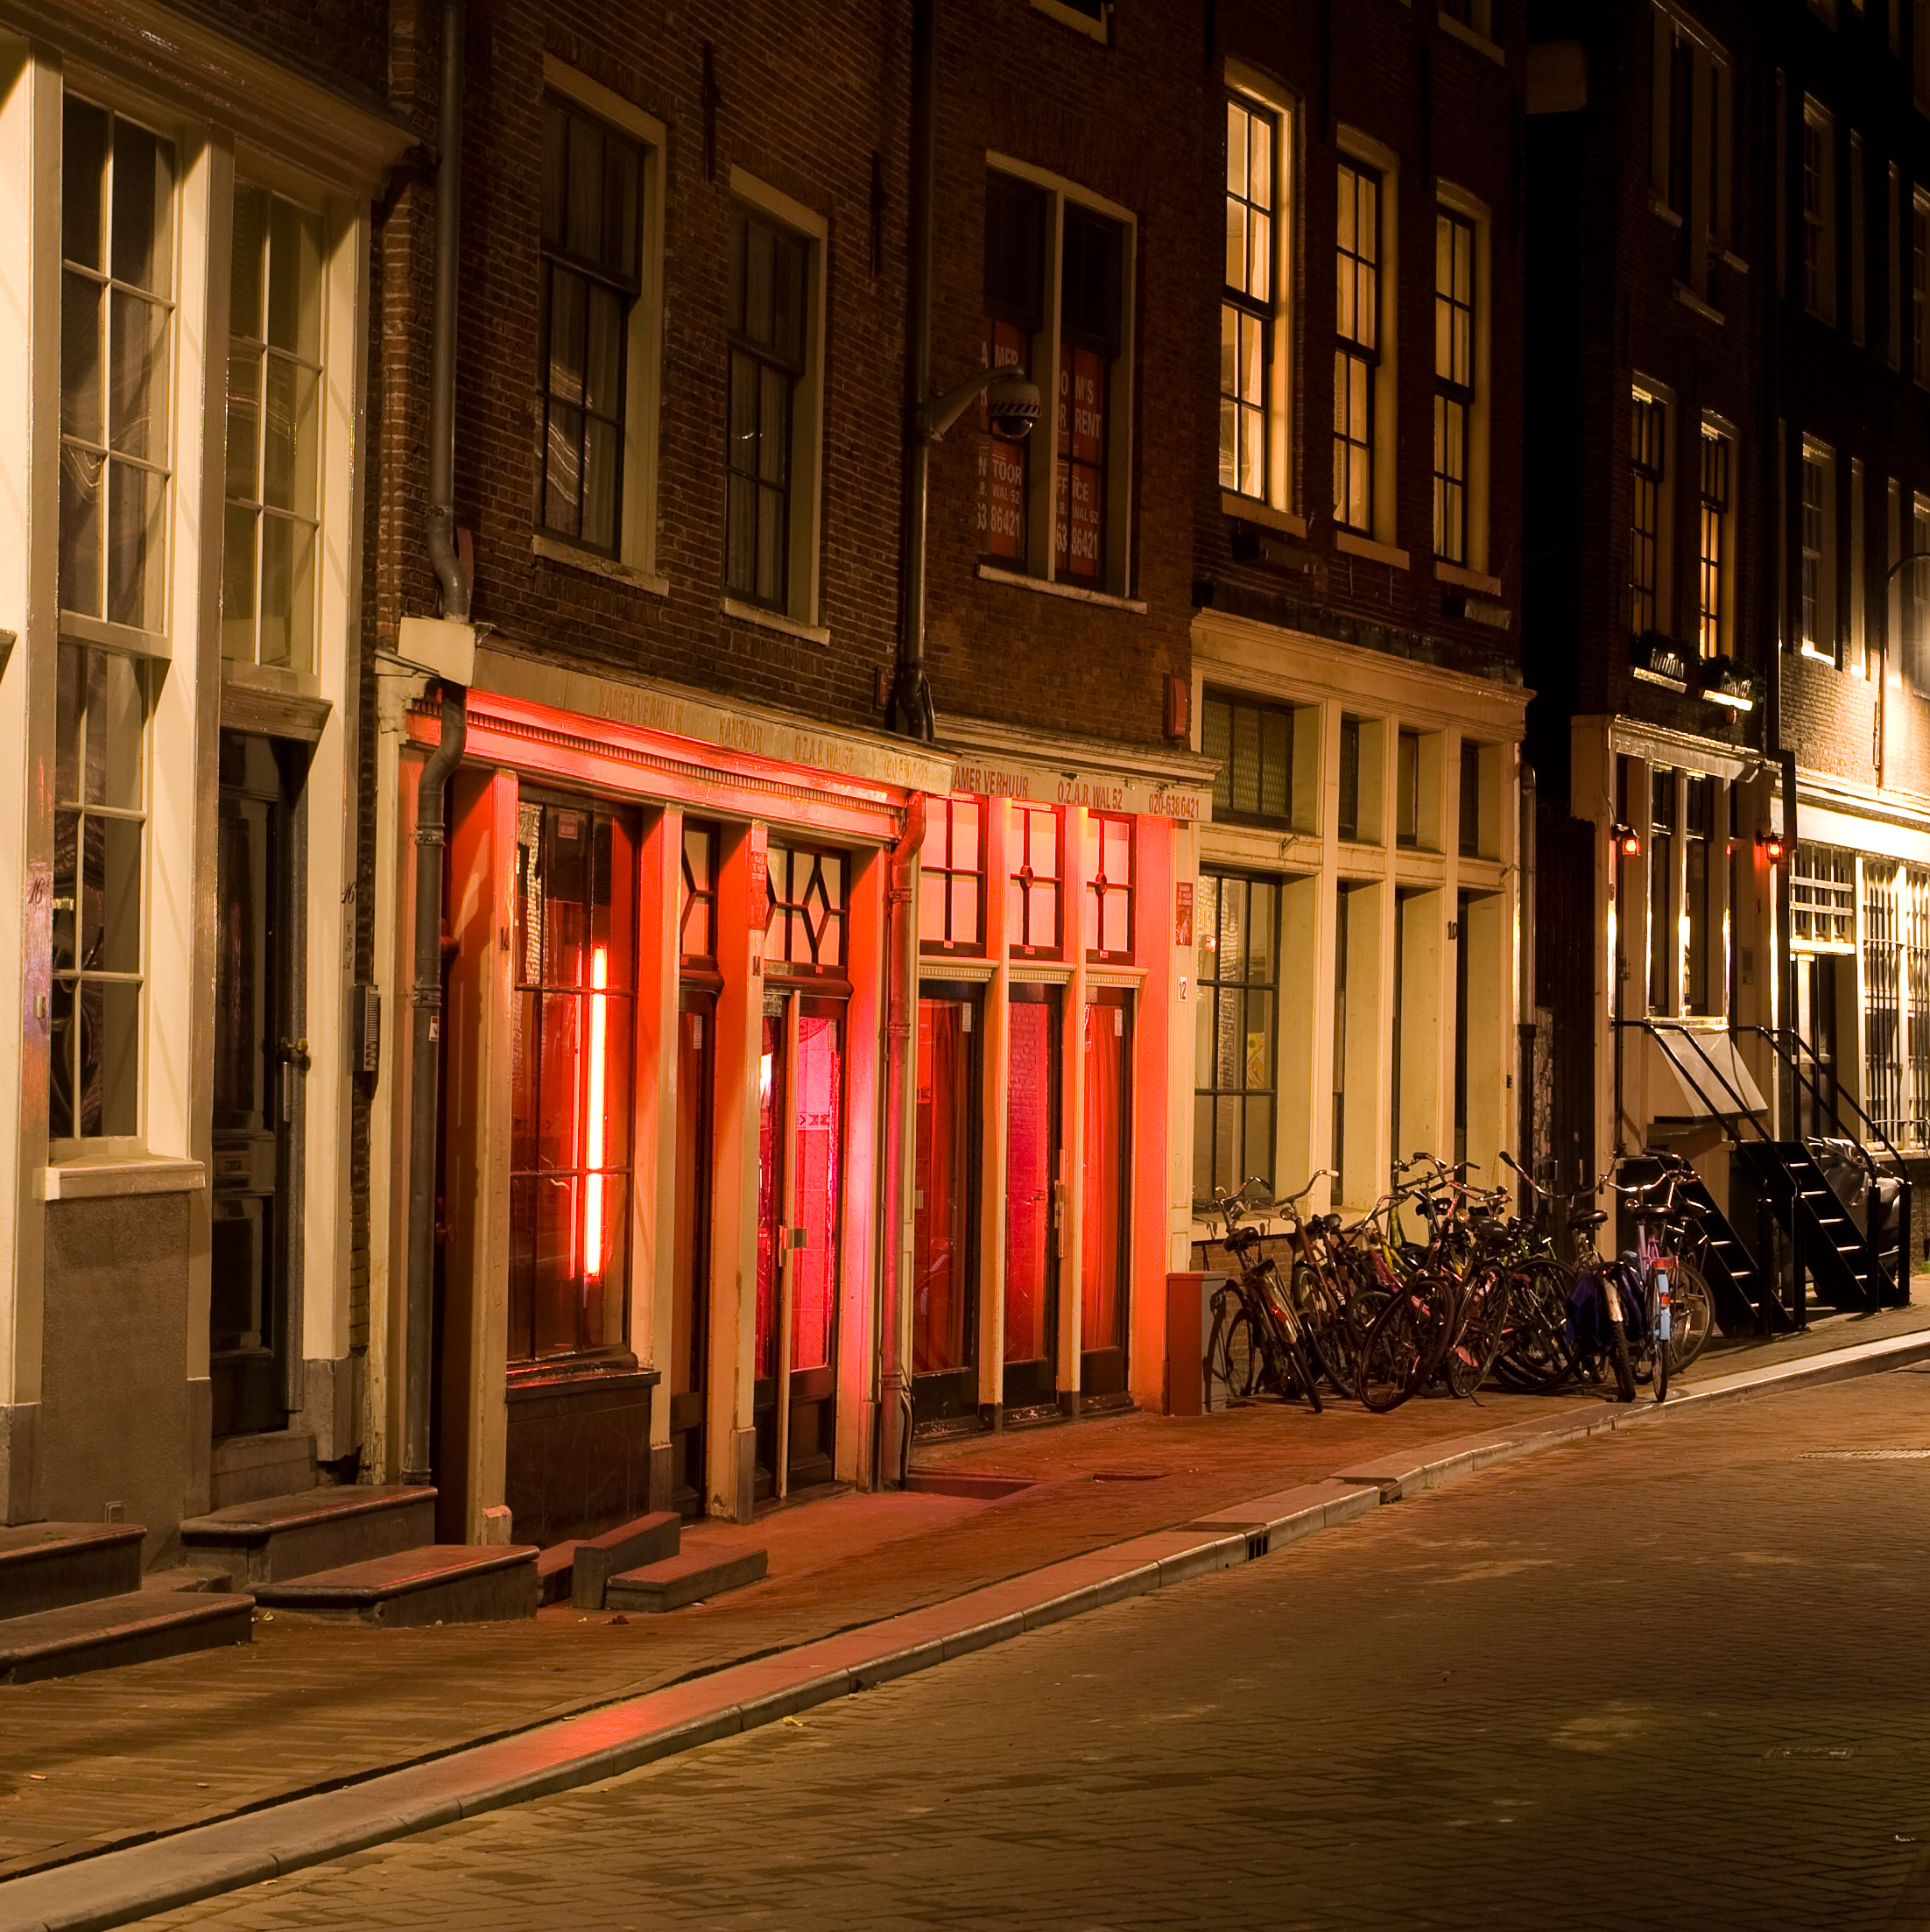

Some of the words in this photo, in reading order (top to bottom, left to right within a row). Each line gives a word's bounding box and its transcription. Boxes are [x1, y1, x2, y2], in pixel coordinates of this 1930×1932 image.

[1075, 407, 1101, 439] RENT
[992, 483, 1009, 501] WAL
[1011, 489, 1020, 504] 52
[1073, 504, 1088, 522] WAL
[1089, 510, 1099, 525] 52
[718, 716, 763, 753] KANTOOR
[983, 770, 1029, 799] VERHUUR
[1093, 785, 1110, 809] WAL
[1112, 787, 1123, 810] 52
[1179, 980, 1187, 1000] 12
